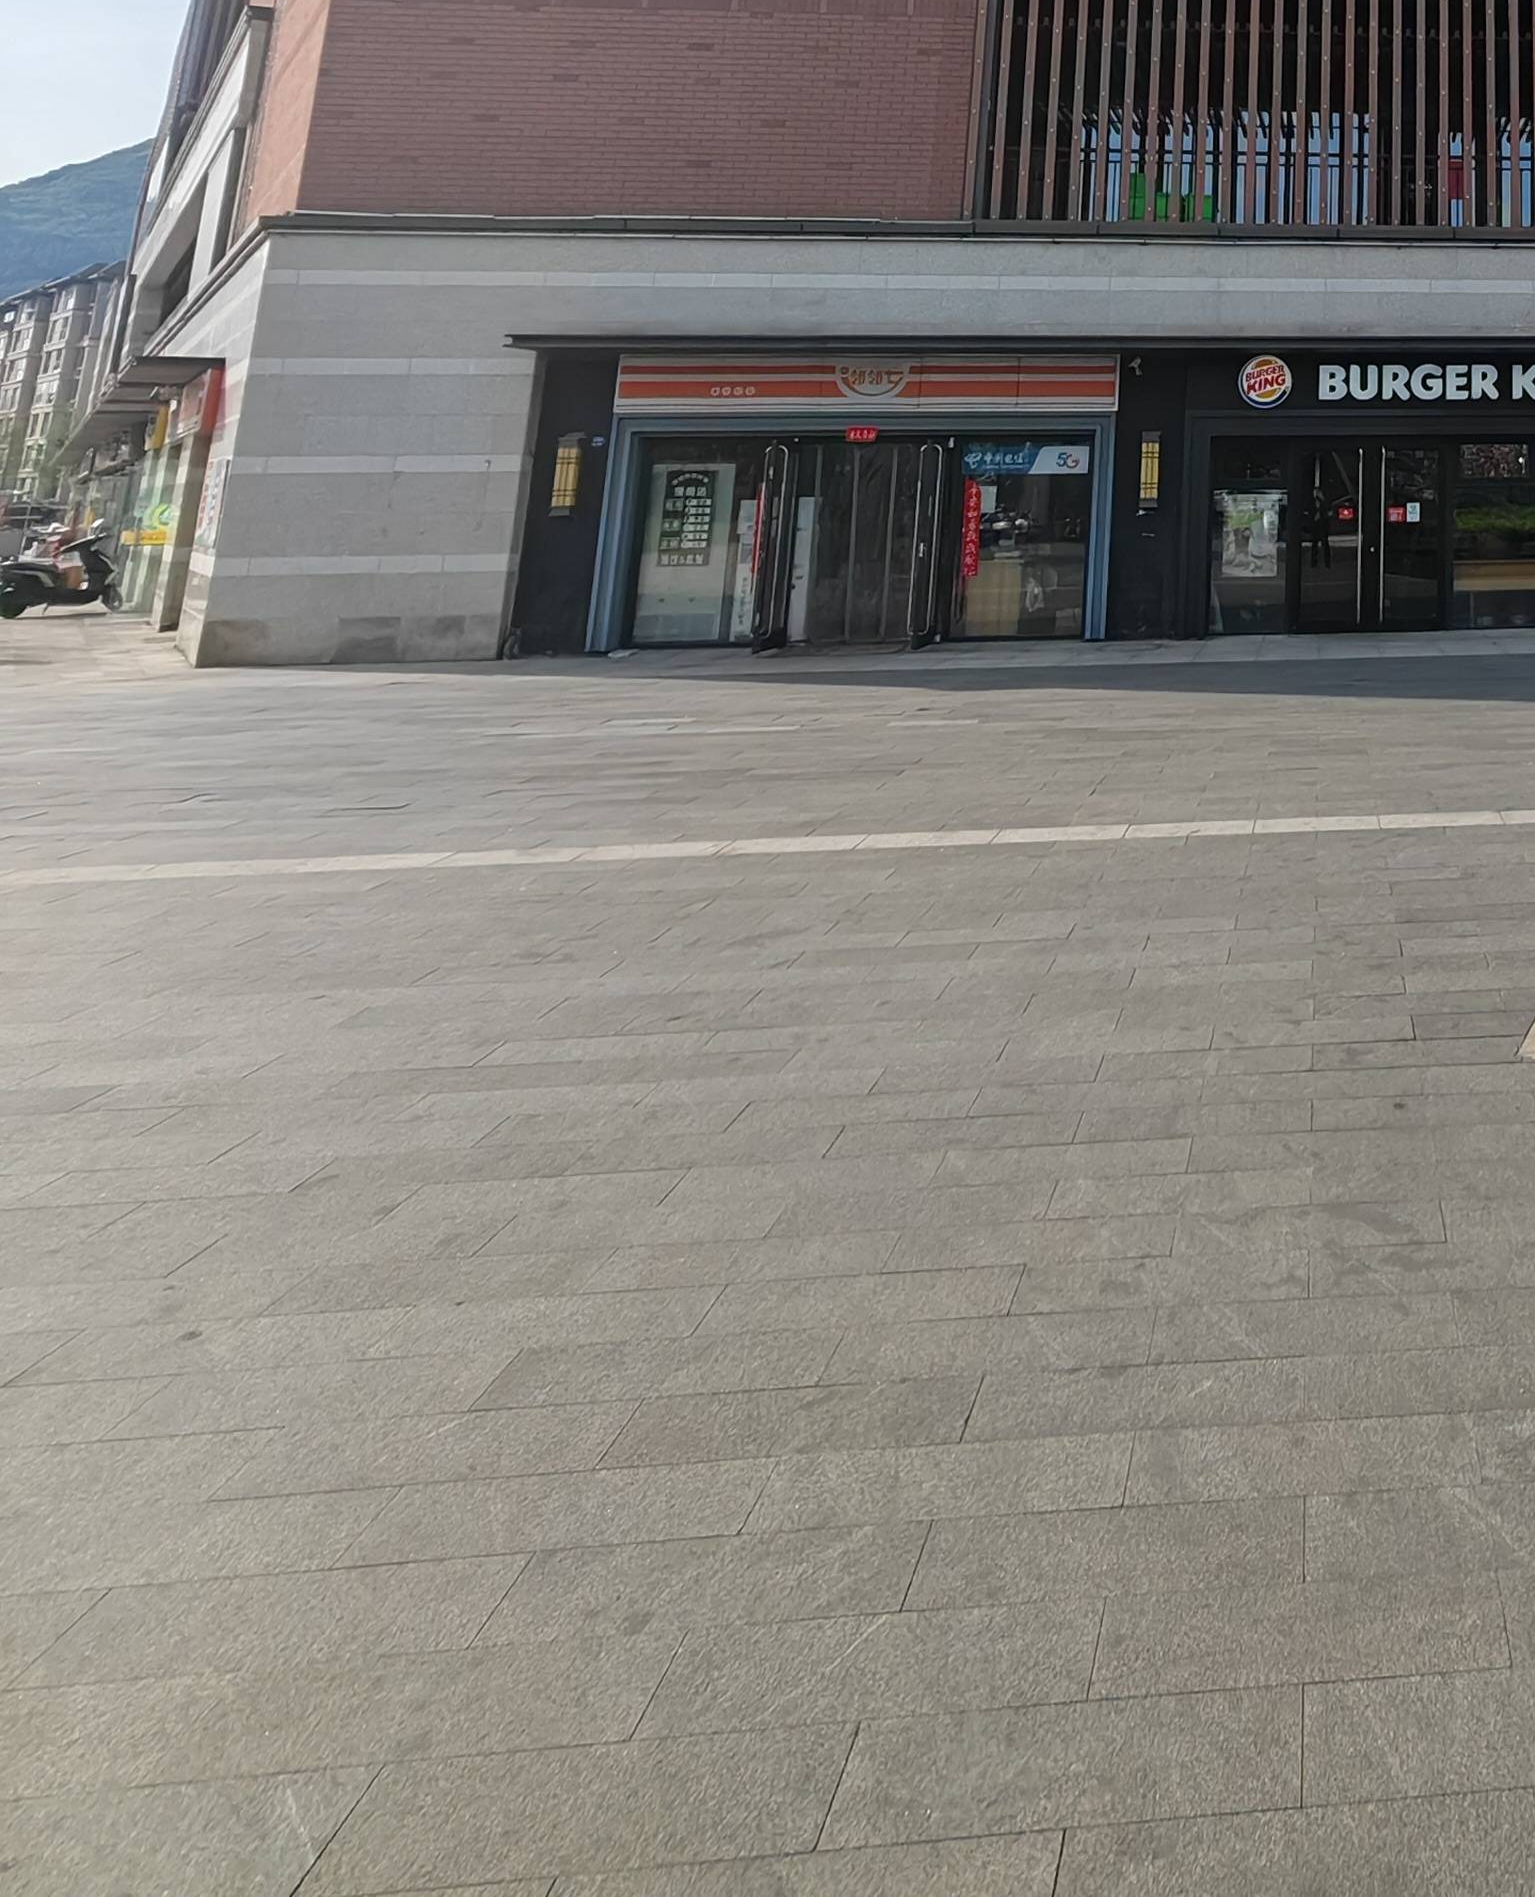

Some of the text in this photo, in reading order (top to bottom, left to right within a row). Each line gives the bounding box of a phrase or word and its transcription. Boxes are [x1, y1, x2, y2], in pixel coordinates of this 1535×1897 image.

[1245, 364, 1285, 381] BURGER
[1318, 363, 1500, 401] BURGER
[1246, 373, 1286, 395] KING
[1056, 451, 1080, 469] 5G
